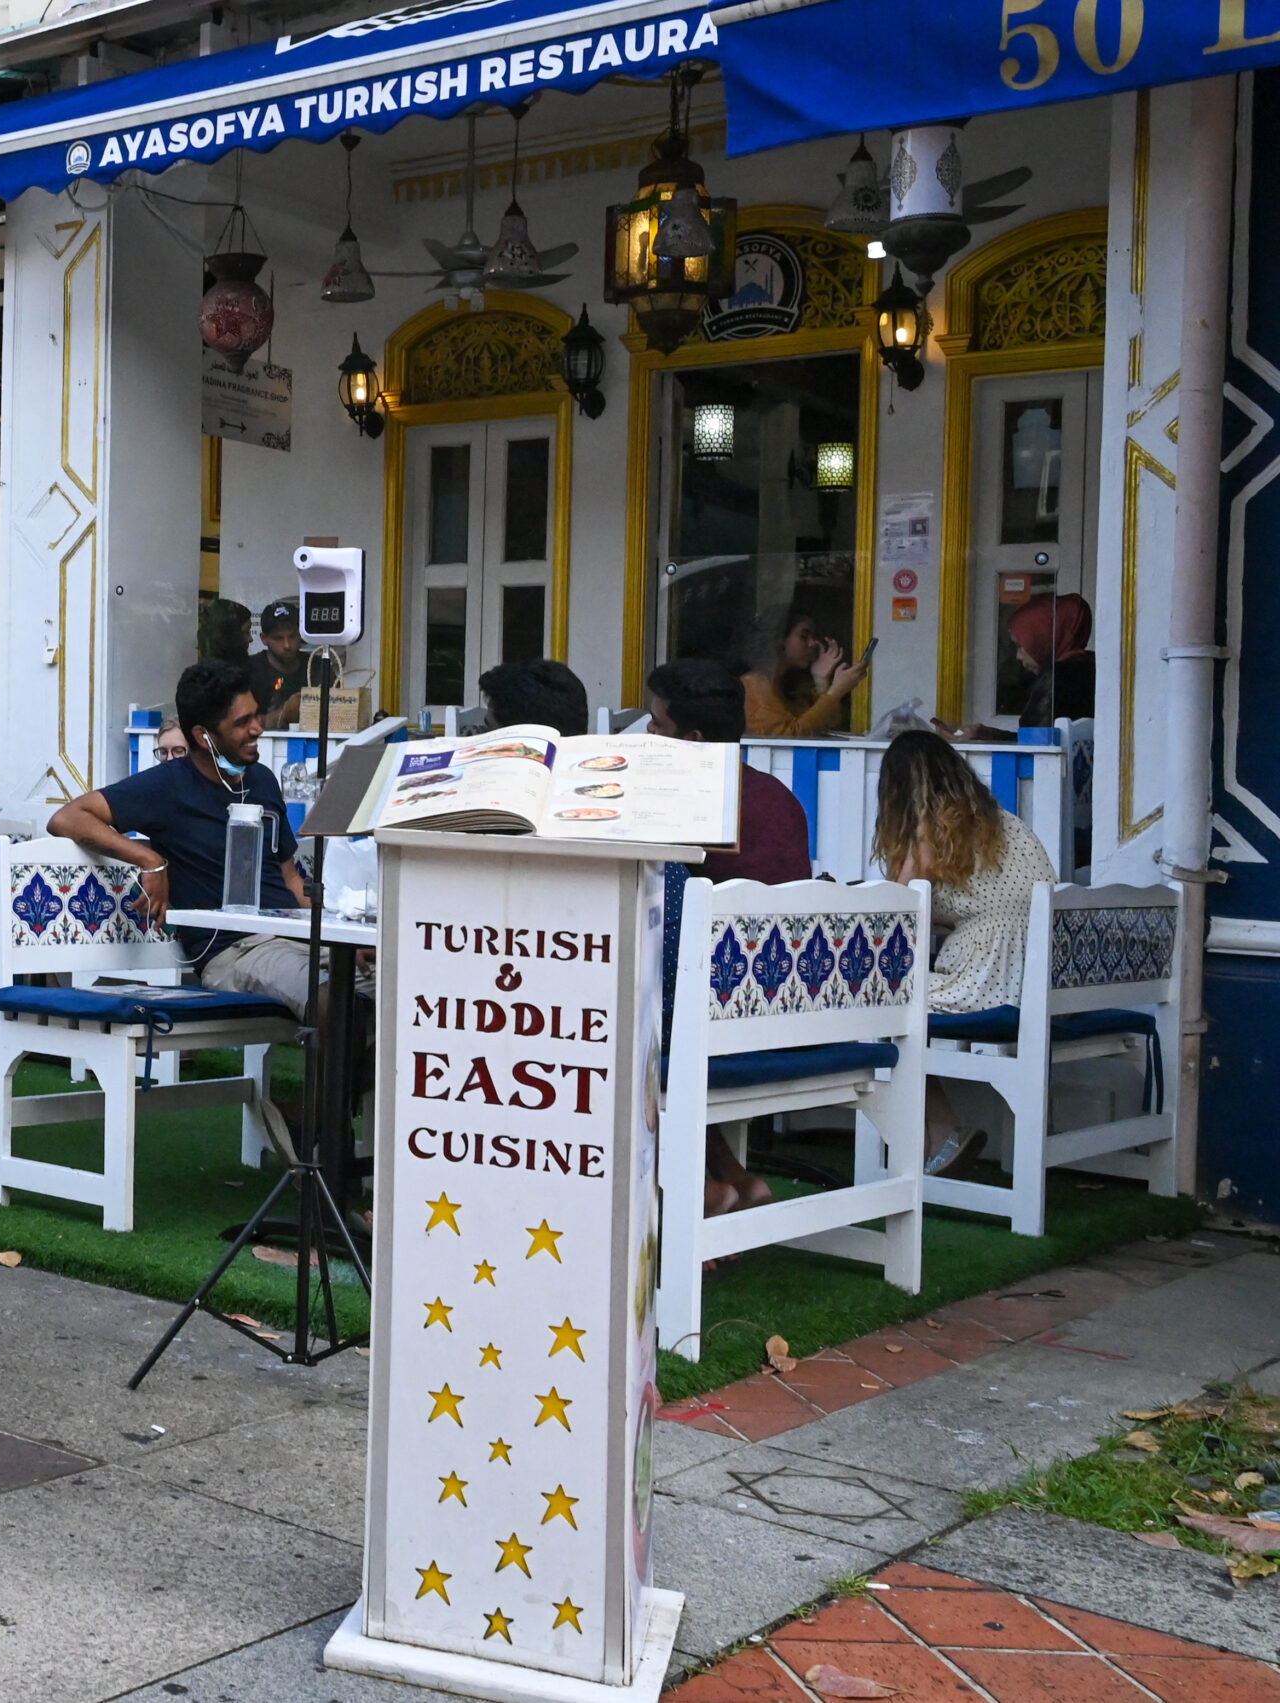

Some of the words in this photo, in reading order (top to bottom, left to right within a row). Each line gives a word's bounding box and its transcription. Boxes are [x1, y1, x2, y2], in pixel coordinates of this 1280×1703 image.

[99, 104, 285, 168] AYASOFYA
[294, 64, 469, 129] TURKISH
[479, 13, 719, 93] RESTAURA
[415, 921, 611, 963] TURKISH
[495, 963, 522, 992] &
[412, 994, 608, 1043] MIDDLE
[411, 1051, 608, 1115] EAST
[408, 1127, 605, 1179] CUISINE
